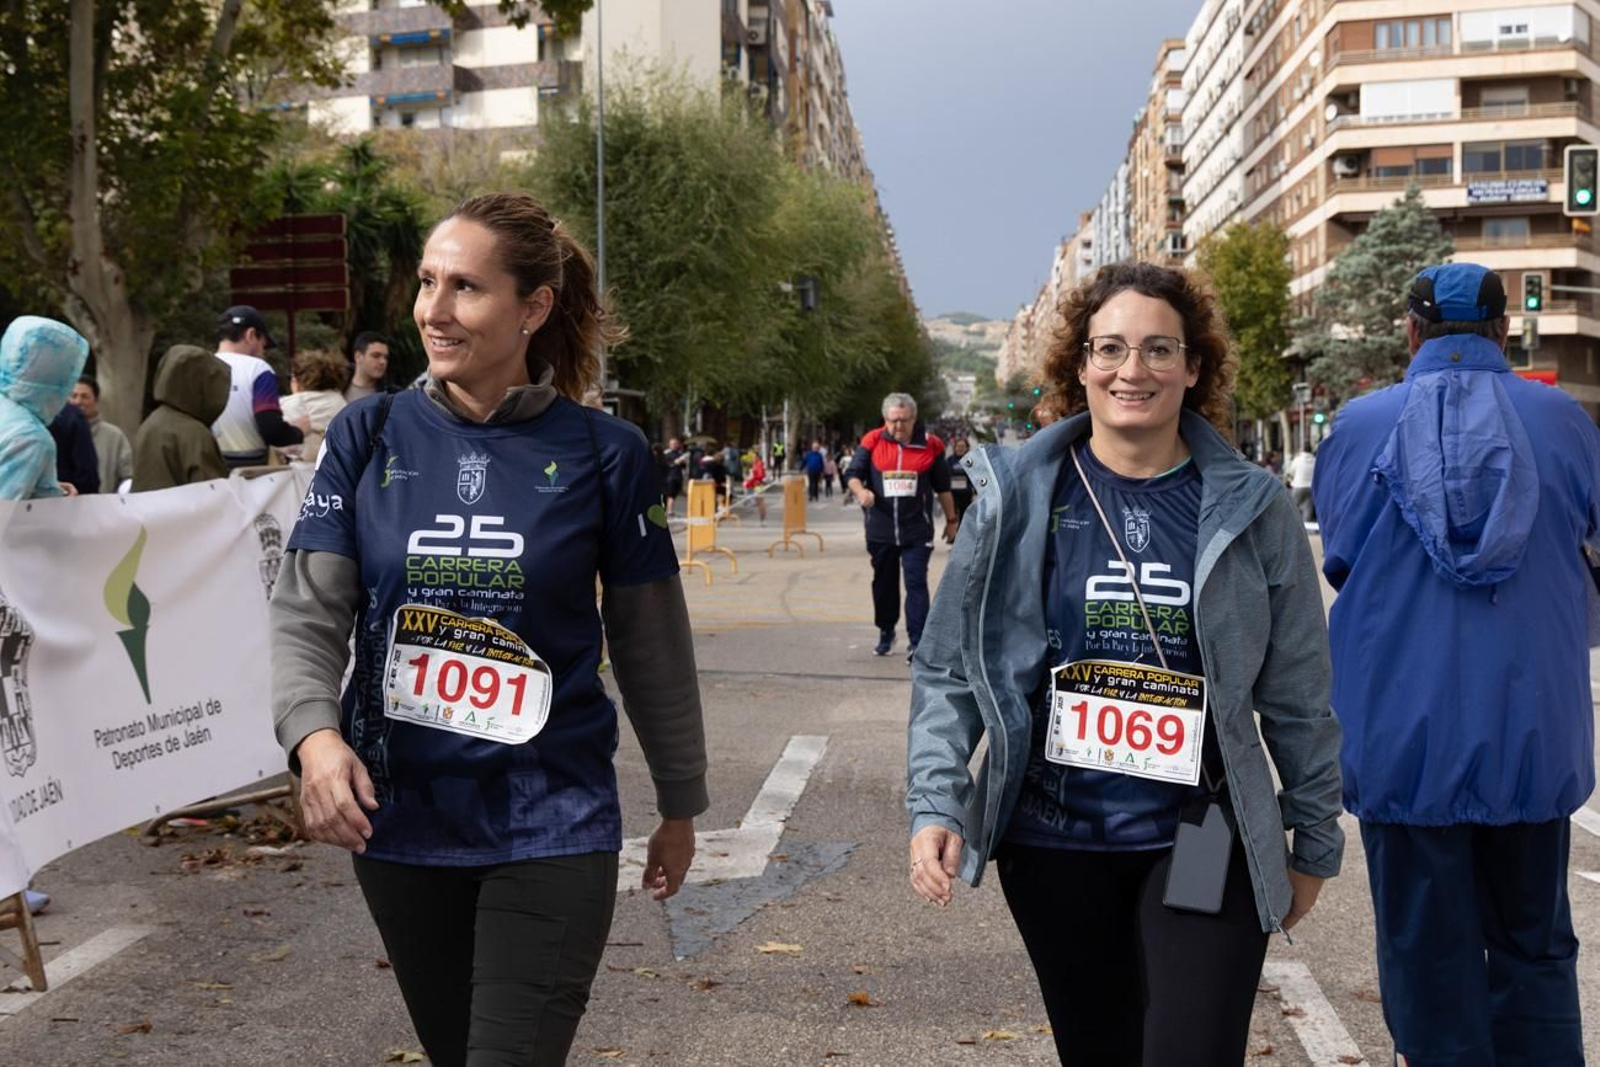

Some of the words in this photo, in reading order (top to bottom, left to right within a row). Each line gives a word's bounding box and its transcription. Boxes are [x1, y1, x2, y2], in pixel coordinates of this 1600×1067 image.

[407, 514, 524, 558] 25
[406, 556, 522, 573] CARRERA
[407, 571, 525, 588] POPULAR
[1085, 560, 1190, 606] 25
[408, 588, 417, 597] y
[421, 588, 453, 597] gran
[458, 590, 524, 599] caminata
[402, 610, 439, 632] XXV
[441, 615, 494, 636] CARRERA
[1085, 601, 1188, 621] CARRERA
[454, 629, 486, 641] gran
[492, 637, 525, 654] camin
[1086, 631, 1096, 640] y
[1099, 630, 1127, 640] gran
[408, 653, 528, 717] 1091
[1060, 664, 1092, 682] XXV
[1094, 665, 1143, 680] CARRERA
[1147, 672, 1199, 688] POPULAR
[1107, 677, 1136, 687] gran
[1143, 681, 1199, 696] caminata
[93, 720, 146, 748] Patronato
[146, 702, 204, 733] Municipal
[205, 698, 222, 716] de
[1071, 700, 1185, 756] 1069
[111, 743, 163, 770] Deportes
[165, 735, 181, 754] de
[183, 724, 212, 748] Jaén
[39, 775, 64, 809] JAÉN
